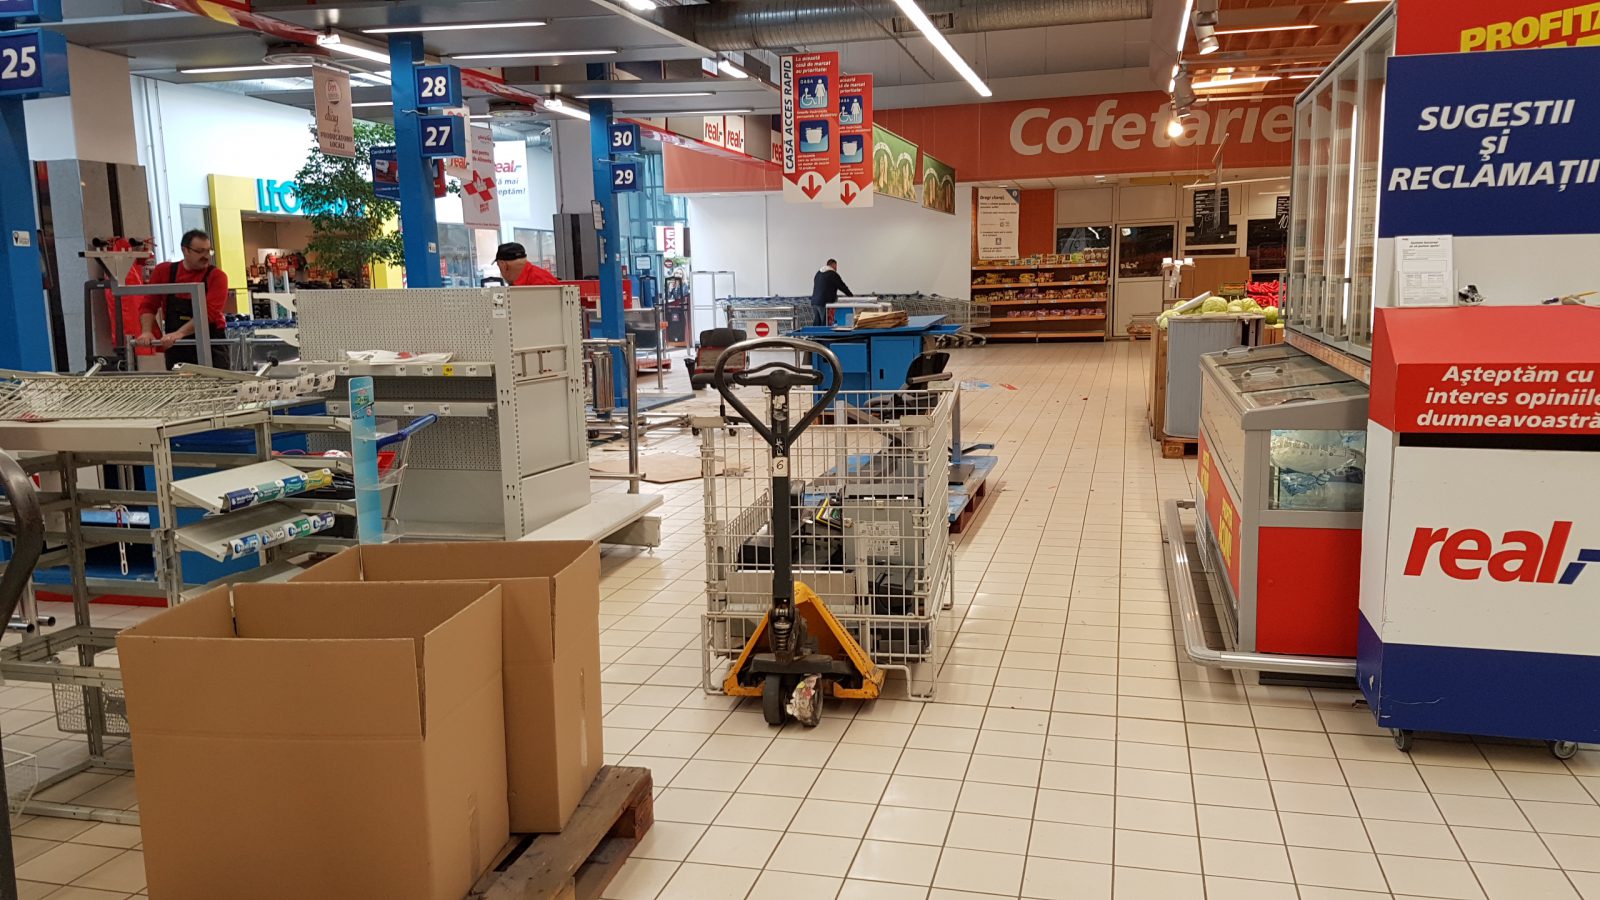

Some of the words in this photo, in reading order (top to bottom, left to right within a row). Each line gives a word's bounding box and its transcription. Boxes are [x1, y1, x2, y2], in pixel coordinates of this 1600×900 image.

[1, 46, 37, 79] 25
[421, 76, 447, 97] 28
[783, 61, 792, 95] RAPID
[784, 99, 793, 135] ACCES
[1417, 99, 1576, 131] SUGESTII
[425, 126, 451, 147] 27
[612, 131, 633, 147] 30
[614, 169, 634, 185] 29
[1566, 369, 1594, 383] cu
[1425, 387, 1509, 406] interes
[776, 460, 784, 470] 6
